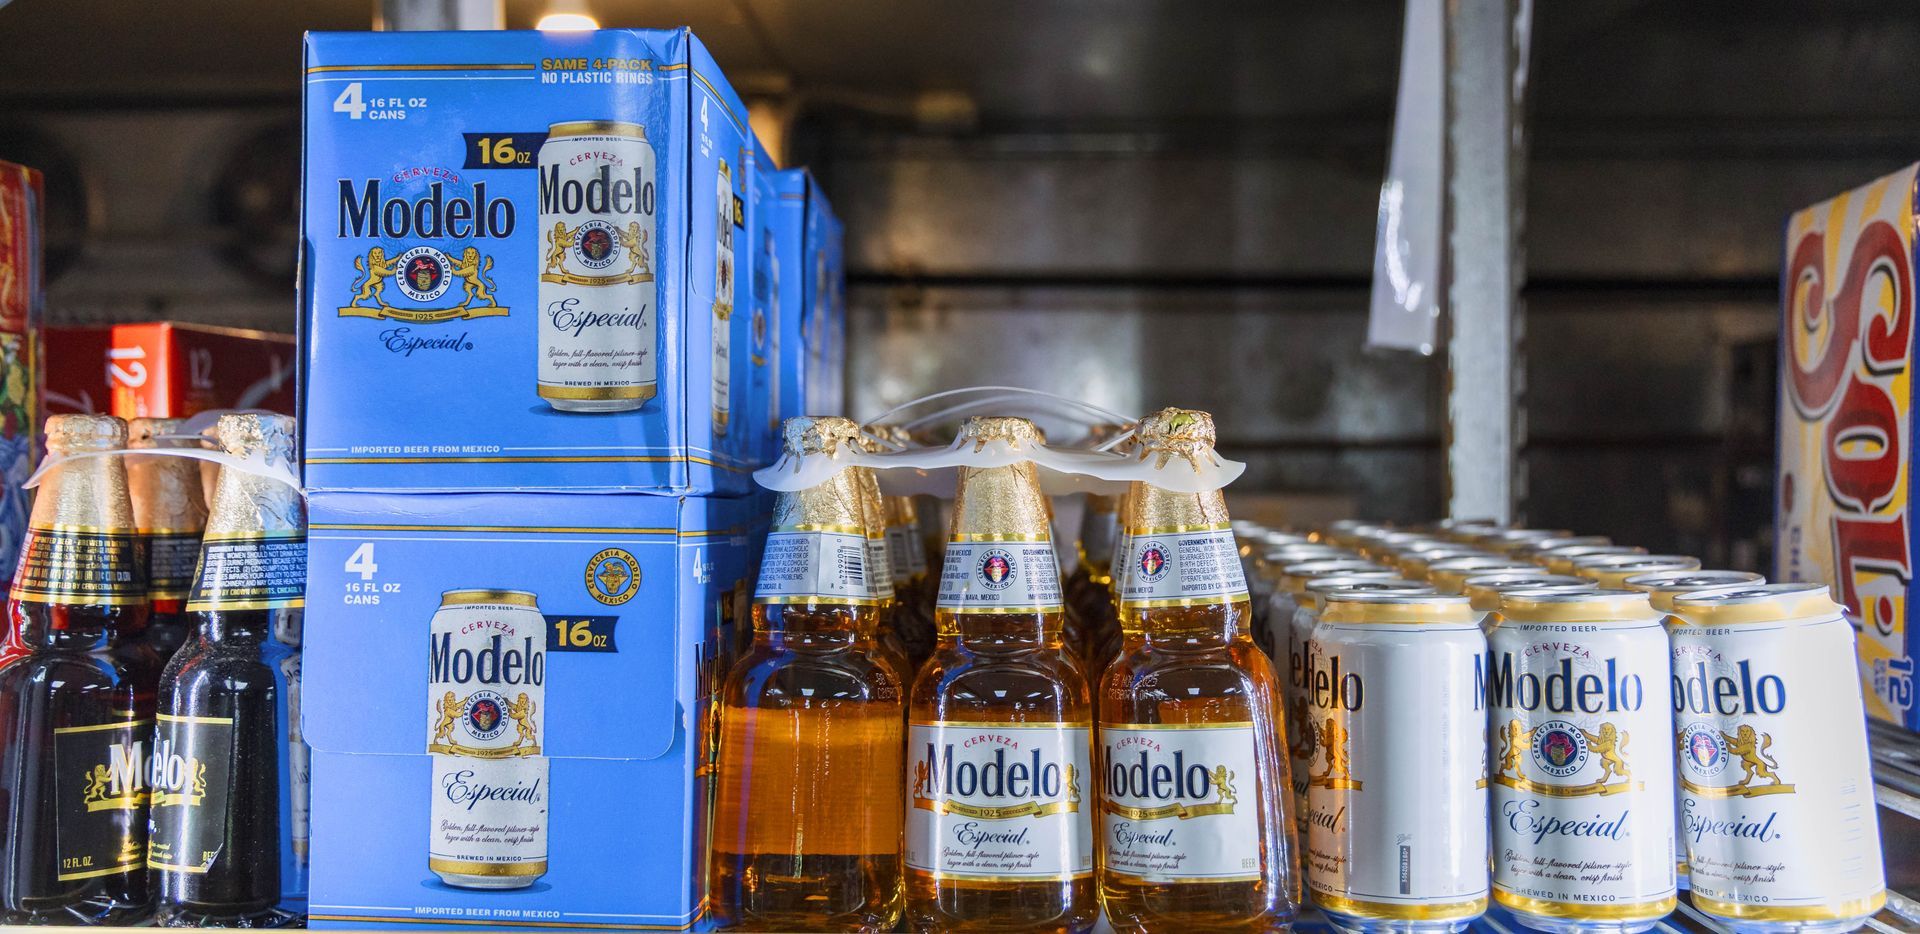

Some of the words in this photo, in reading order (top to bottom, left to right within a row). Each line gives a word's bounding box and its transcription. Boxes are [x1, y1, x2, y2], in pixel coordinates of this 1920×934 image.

[542, 59, 587, 70] SAME
[592, 58, 652, 71] 4-PACK
[541, 72, 558, 84] NO
[561, 72, 612, 84] PLASTIC
[616, 72, 654, 85] RINGS
[333, 82, 367, 120] 4
[370, 98, 385, 108] 16
[390, 98, 405, 108] FL
[408, 98, 428, 108] OZ
[369, 110, 406, 120] CANS
[700, 96, 708, 133] 4
[570, 152, 624, 167] CERVEZA
[394, 167, 458, 184] CERVEZA
[540, 164, 654, 216] Modelo
[338, 178, 516, 240] Modelo
[576, 222, 602, 256] CERVECERIA
[606, 225, 618, 256] MODELO
[399, 248, 430, 286] CERVECERIA
[434, 251, 451, 286] MODELO
[584, 258, 612, 268] MEXICO
[408, 290, 440, 300] MEXICO
[107, 345, 147, 388] 12
[351, 446, 401, 454] IMPORTED
[462, 445, 500, 453] MEXICO
[344, 542, 378, 580] 4
[692, 548, 702, 584] 4
[978, 550, 1000, 579] CERVECERIA
[1004, 552, 1015, 579] MODELO
[1160, 545, 1170, 572] MODELO
[588, 550, 620, 590] CERVECERIA
[624, 554, 638, 590] MODELO
[345, 583, 360, 592] 16
[364, 583, 380, 592] FL
[383, 583, 401, 593] OZ
[1182, 584, 1208, 592] IMPORTED
[344, 594, 380, 605] CANS
[597, 594, 629, 604] MEXICO
[462, 620, 515, 637] CERVEZA
[1706, 628, 1730, 636] BEER
[1525, 642, 1590, 658] CERVEZA
[430, 632, 544, 686] Modelo
[1489, 650, 1642, 714] Modelo
[1673, 659, 1786, 716] odelo
[1888, 656, 1914, 710] 12
[464, 694, 491, 726] CERVECERIA
[494, 696, 506, 726] MODELO
[472, 730, 499, 738] MEXICO
[964, 734, 1019, 750] CERVEZA
[1116, 737, 1160, 752] CERVEZA
[1568, 727, 1584, 762] MODELO
[1710, 729, 1726, 763] MODELO
[927, 742, 1060, 798] Modelo
[1101, 744, 1210, 800] Modelo
[1544, 764, 1578, 776] MEXICO
[980, 809, 1000, 817] 1925
[1130, 810, 1148, 818] 1925
[63, 858, 71, 868] 12
[1242, 858, 1256, 869] BEER
[1734, 863, 1785, 876] pilsner-style
[1553, 872, 1576, 881] clean,
[1581, 873, 1599, 884] crisp
[1600, 873, 1623, 884] finish
[1733, 874, 1751, 884] crisp
[1751, 874, 1775, 883] finish
[1573, 894, 1616, 902] MEXICO
[415, 906, 463, 915] IMPORTED
[466, 908, 490, 916] BEER
[494, 909, 520, 917] FROM
[523, 910, 560, 918] MEXICO
